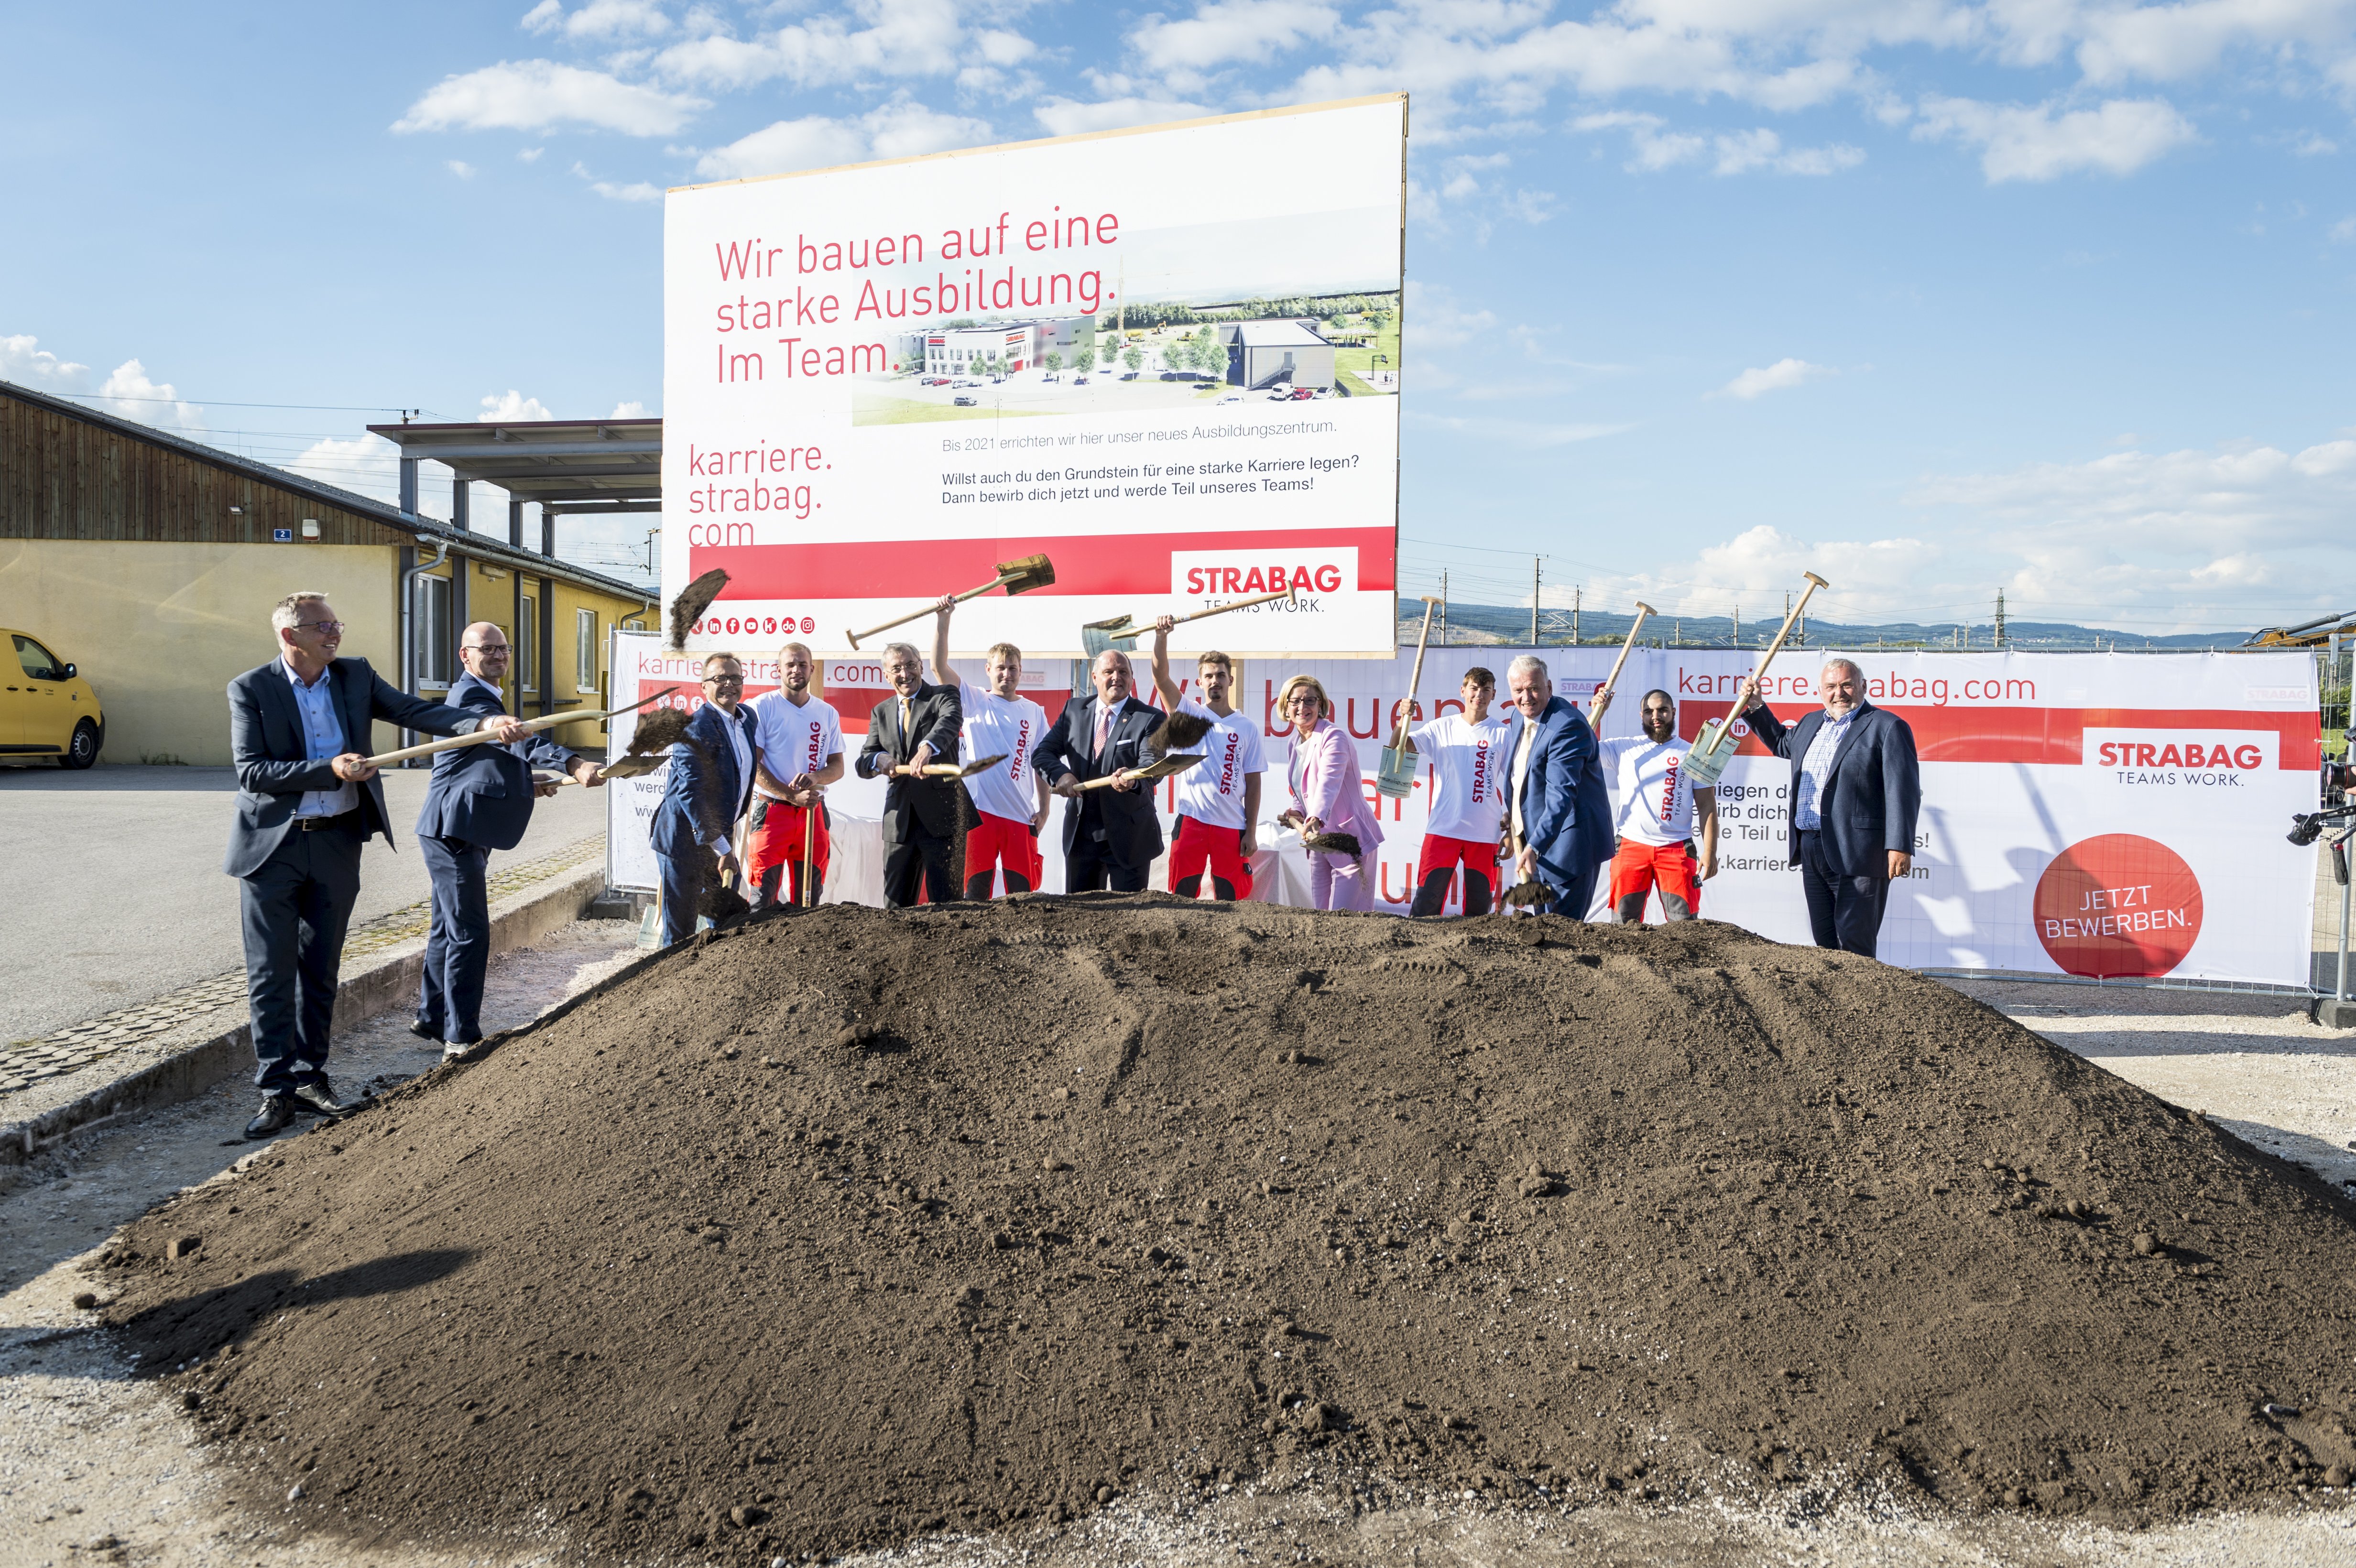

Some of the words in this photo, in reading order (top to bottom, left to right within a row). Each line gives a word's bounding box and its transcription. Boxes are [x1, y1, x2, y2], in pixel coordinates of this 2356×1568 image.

[716, 238, 783, 281] Wir
[799, 234, 922, 273] bauen
[942, 212, 1009, 260] auf
[1026, 206, 1118, 251] eine
[717, 286, 839, 332] starke
[854, 266, 1115, 321] Ausbildung.
[719, 344, 762, 383] Im
[779, 338, 899, 378] Team.
[943, 439, 960, 452] Bis
[965, 438, 993, 450] 2021
[1000, 435, 1053, 449] errichten
[1058, 433, 1077, 446] wir
[1080, 432, 1103, 445] hier
[1108, 432, 1144, 443] unser
[1148, 429, 1188, 441] neues
[1192, 421, 1337, 439] Ausbildungszentrum.
[690, 439, 831, 476] karriere.
[942, 472, 976, 485] Willst
[981, 471, 1011, 484] auch
[1015, 470, 1031, 482] du
[1036, 469, 1060, 481] den
[1065, 466, 1138, 480] Grundstein
[1143, 464, 1162, 477] für
[1166, 463, 1194, 476] eine
[1199, 460, 1243, 474] starke
[1248, 458, 1305, 472] Karriere
[1310, 455, 1359, 472] legen?
[689, 478, 821, 519] strabag.
[942, 492, 975, 504] Dann
[980, 490, 1024, 502] bewirb
[1028, 488, 1056, 501] dich
[1060, 487, 1090, 502] jetzt
[1094, 485, 1119, 498] und
[1124, 484, 1167, 497] werde
[1172, 482, 1194, 495] Teil
[1200, 482, 1256, 494] unseres
[1262, 477, 1313, 491] Teams!
[689, 523, 754, 547] com
[1187, 565, 1341, 594] STRABAG
[1268, 599, 1324, 612] WORK.
[2247, 690, 2308, 700] STRABAG
[1010, 719, 1029, 781] STRABAG
[1220, 732, 1239, 795] STRABAG
[2099, 742, 2262, 770] STRABAG
[1472, 740, 1489, 803] STRABAG
[2117, 772, 2176, 785] TEAMS
[2184, 773, 2244, 786] WORK.
[1660, 756, 1679, 821] STRABAG
[1748, 805, 1788, 820] dich
[1738, 825, 1768, 840] Teil
[2080, 885, 2151, 912] JETZT
[2046, 908, 2192, 938] BEWERBEN.
